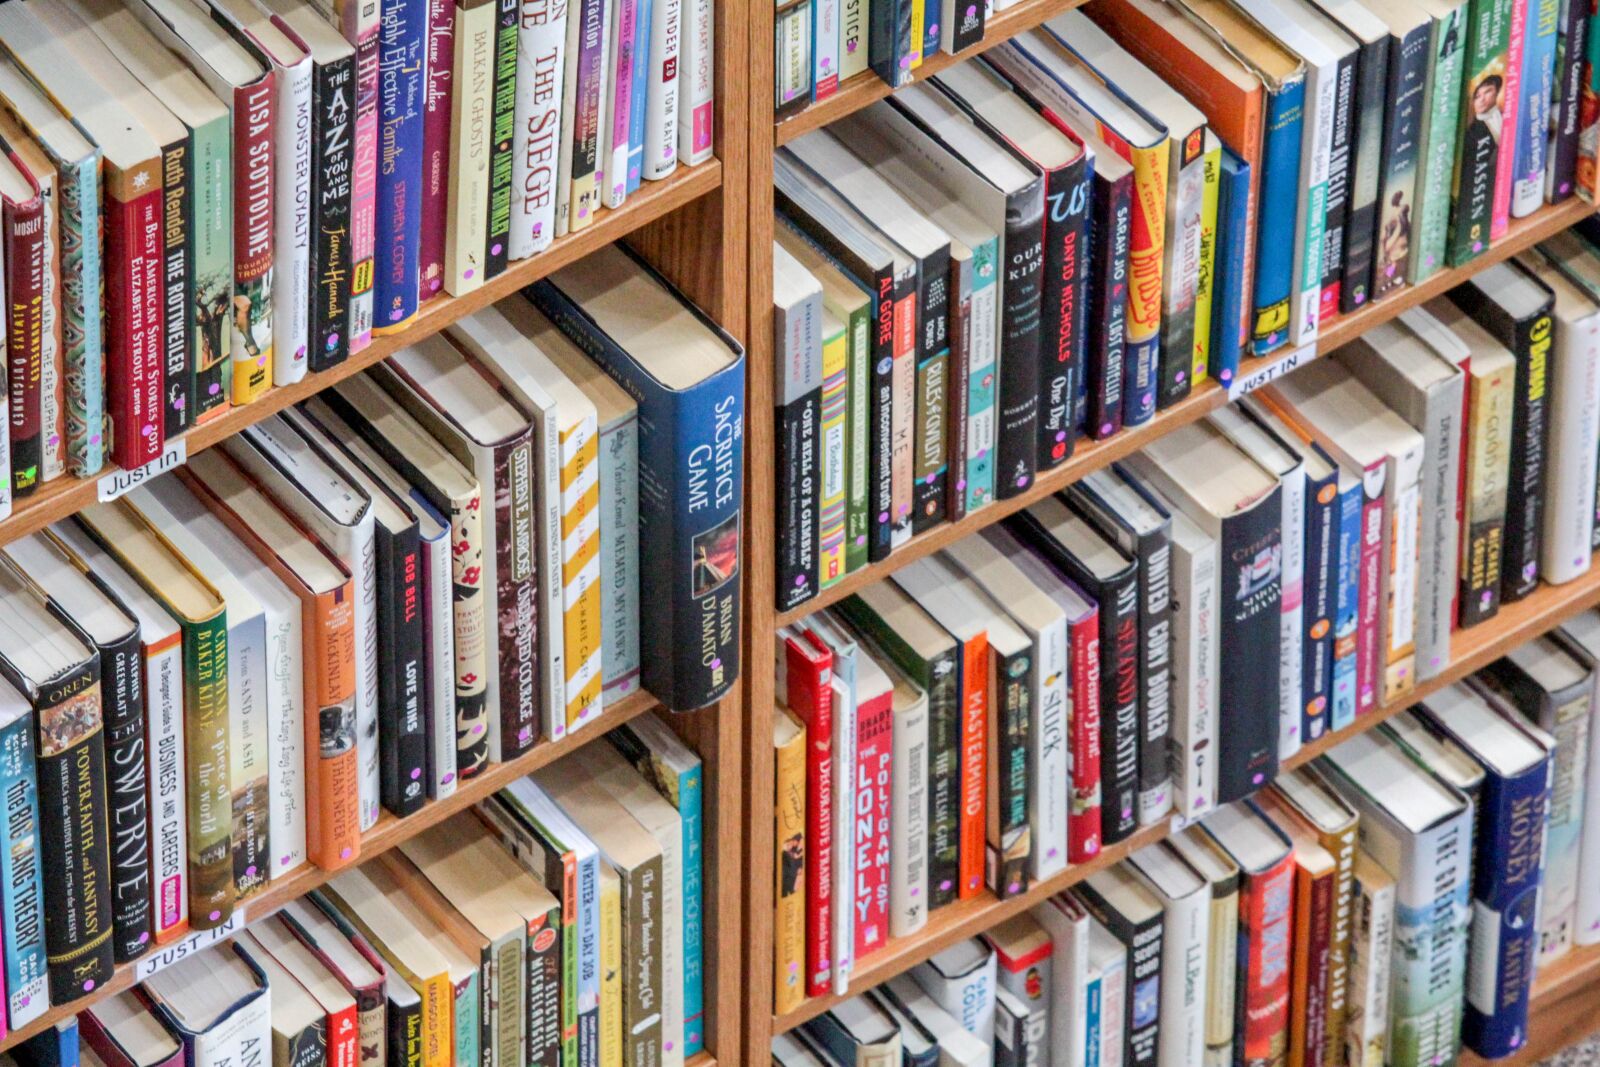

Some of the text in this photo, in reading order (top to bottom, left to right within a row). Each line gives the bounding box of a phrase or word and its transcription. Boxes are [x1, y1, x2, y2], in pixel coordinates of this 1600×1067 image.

[329, 69, 349, 88] THE
[409, 37, 420, 58] The
[428, 18, 453, 112] House Ladies
[327, 87, 349, 118] A
[333, 113, 346, 126] TO
[358, 54, 377, 131] HEART
[379, 3, 407, 175] Highly Effective Families
[470, 30, 486, 159] BALKAN GHOSTS
[665, 90, 674, 116] TOM
[296, 101, 309, 183] MONSTER
[324, 122, 348, 156] Z
[331, 151, 343, 163] OF
[524, 47, 558, 215] THE SIEGE
[248, 88, 269, 257] LISA SCOTTOLINE
[322, 183, 349, 204] ME
[324, 158, 348, 176] YOU
[328, 173, 348, 185] AND
[1326, 146, 1350, 212] AMELIA
[1472, 136, 1490, 220] KLASSEN
[13, 216, 42, 237] MOSLEY
[294, 185, 308, 250] LOYALTY
[392, 181, 405, 284] STEPHEN COVEY
[1113, 206, 1128, 281] SARAH JIO
[32, 242, 41, 290] ALWAYS
[165, 147, 185, 376] Ruth Rendell THE ROTTWEILER
[321, 225, 346, 319] James Hannah
[1009, 254, 1043, 280] KIDS
[1013, 242, 1041, 264] OUR
[131, 257, 143, 330] ELIZABETH
[879, 277, 892, 345] AL GORE
[1058, 231, 1076, 362] DAVID NICHOLLS
[13, 304, 27, 351] ALWAYS
[146, 222, 160, 453] BEST AMERICAN STORIES 2013
[1105, 319, 1123, 405] LAST CAMELLIA
[1240, 355, 1298, 394] JUST IN
[734, 414, 742, 440] THE
[925, 362, 942, 468] RULES CIVILITY
[1046, 375, 1067, 430] One Day
[1524, 337, 1551, 493] BATMAN KNIGHTFALL
[715, 395, 734, 509] SACRIFICE
[801, 440, 812, 495] HELL OF
[879, 386, 891, 511] an inconvenient truth
[894, 429, 907, 457] ME
[1485, 416, 1499, 468] GOOD
[688, 444, 713, 514] GAME
[515, 448, 530, 579] STEPHEN AMBROSE
[404, 553, 416, 622] ROB BELL
[1472, 537, 1486, 590] GRUBER
[1486, 527, 1500, 586] MICHAEL
[702, 596, 716, 667] D'AMATO
[720, 594, 732, 646] BRIAN
[1199, 588, 1210, 610] The
[1199, 611, 1210, 636] Best
[327, 632, 341, 701] McKINLAY
[516, 583, 532, 722] UNDAUNTED COURAGE
[1148, 545, 1169, 742] UNITED CORY BOOKER
[1198, 637, 1210, 678] Kitchen
[50, 673, 92, 703] OREN
[115, 652, 128, 717] GREENBLATT
[130, 653, 139, 701] STEPHEN
[197, 630, 214, 728] BAKER KLINE
[405, 660, 418, 733] LOVE WINS
[1117, 581, 1136, 778] MY SECOND DEATH
[240, 677, 254, 770] SAND ASH
[860, 709, 890, 731] BRADY
[860, 745, 877, 760] THE
[158, 736, 176, 797] BUSINESS
[211, 738, 228, 779] piece
[937, 752, 948, 775] THE
[966, 690, 983, 816] MASTERMIND
[114, 738, 149, 900] SWERVE
[163, 799, 175, 818] AND
[200, 762, 216, 834] the world
[332, 760, 345, 841] THAN NEVER
[936, 780, 948, 821] WELSH
[1010, 794, 1025, 825] KING
[160, 820, 179, 877] CAREERS
[856, 764, 874, 922] LONELY
[876, 752, 891, 913] POLYGAMIST
[936, 825, 948, 856] GIRL
[1436, 826, 1458, 866] THE
[1506, 795, 1532, 885] MONEY
[82, 870, 98, 935] FANTASY
[642, 890, 654, 919] Master
[818, 847, 830, 899] FRAMES
[1433, 865, 1455, 929] GREAT
[13, 881, 40, 951] THEORY
[582, 858, 596, 981] WRITER DAY JOB
[686, 864, 700, 982] THE HONEST LIFE
[1332, 831, 1355, 1010] PENINSULA LIES
[146, 934, 200, 974] JUST
[502, 948, 517, 1020] COURTESANS
[1503, 936, 1523, 1006] MAYER
[429, 982, 439, 1028] MARIGOLD
[531, 957, 544, 1060] MICHELANGELO
[545, 982, 558, 1047] ELECTRIC
[974, 976, 988, 1013] GAIL
